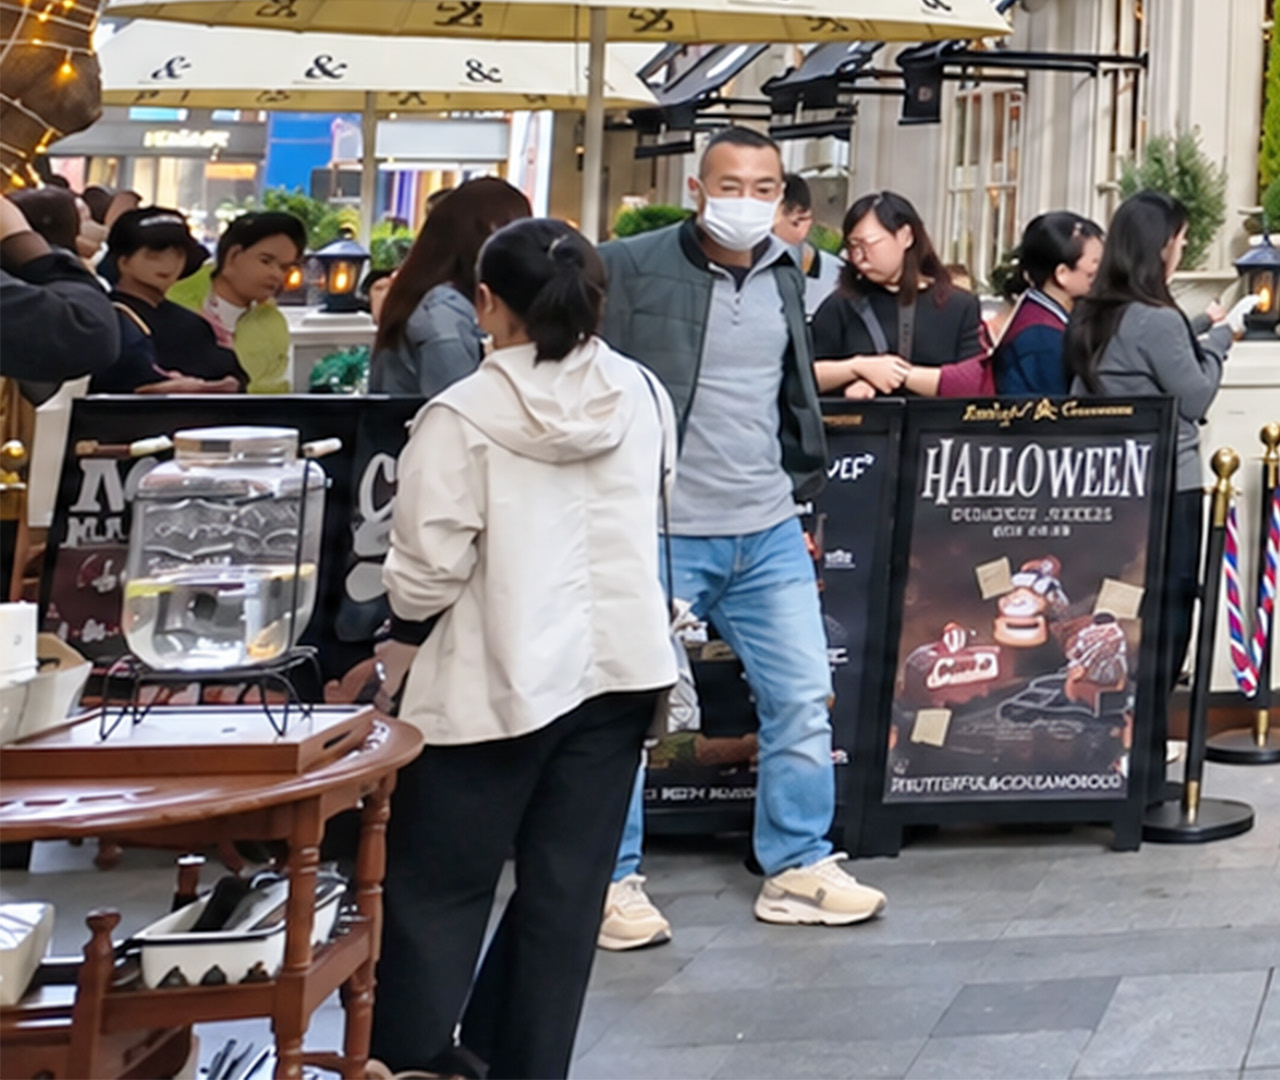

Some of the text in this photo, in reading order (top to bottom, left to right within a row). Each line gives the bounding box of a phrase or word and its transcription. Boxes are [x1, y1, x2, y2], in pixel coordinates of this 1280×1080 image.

[151, 55, 192, 80] &
[305, 54, 347, 80] &
[465, 58, 502, 83] &
[921, 438, 1152, 506] HALLOWEEN
